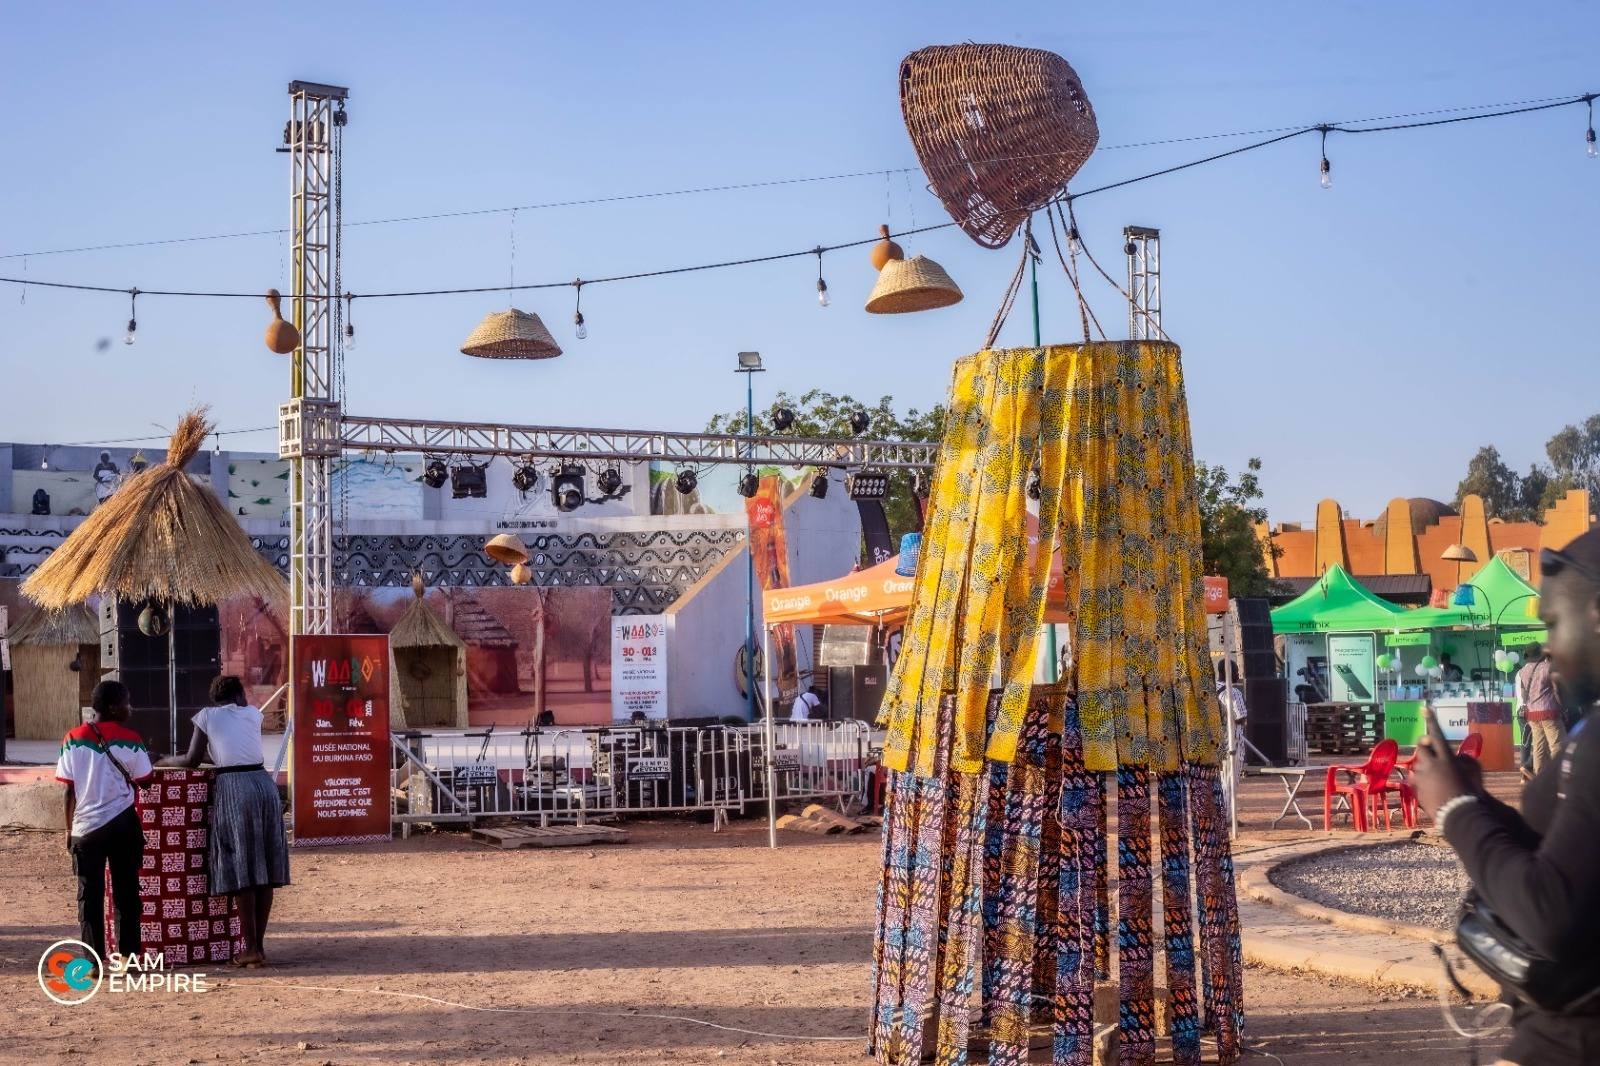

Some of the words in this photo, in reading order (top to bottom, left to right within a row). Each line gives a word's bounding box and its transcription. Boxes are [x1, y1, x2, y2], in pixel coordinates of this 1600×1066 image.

[825, 586, 869, 602] Orange
[770, 595, 811, 611] Orange
[1298, 620, 1330, 629] Infinix
[622, 647, 635, 656] 30
[316, 719, 333, 728] Jan.
[348, 717, 365, 727] Fév.
[312, 742, 337, 751] MUSÉE
[337, 743, 371, 751] NATIONAL
[324, 754, 353, 762] BURKINA
[325, 778, 361, 787] VALORISER
[314, 789, 321, 797] LA
[352, 787, 372, 796] C'EST
[313, 799, 347, 807] DÉFENDRE
[357, 798, 372, 806] QUE
[317, 810, 336, 818] NOUS
[337, 809, 369, 817] SOMMES.
